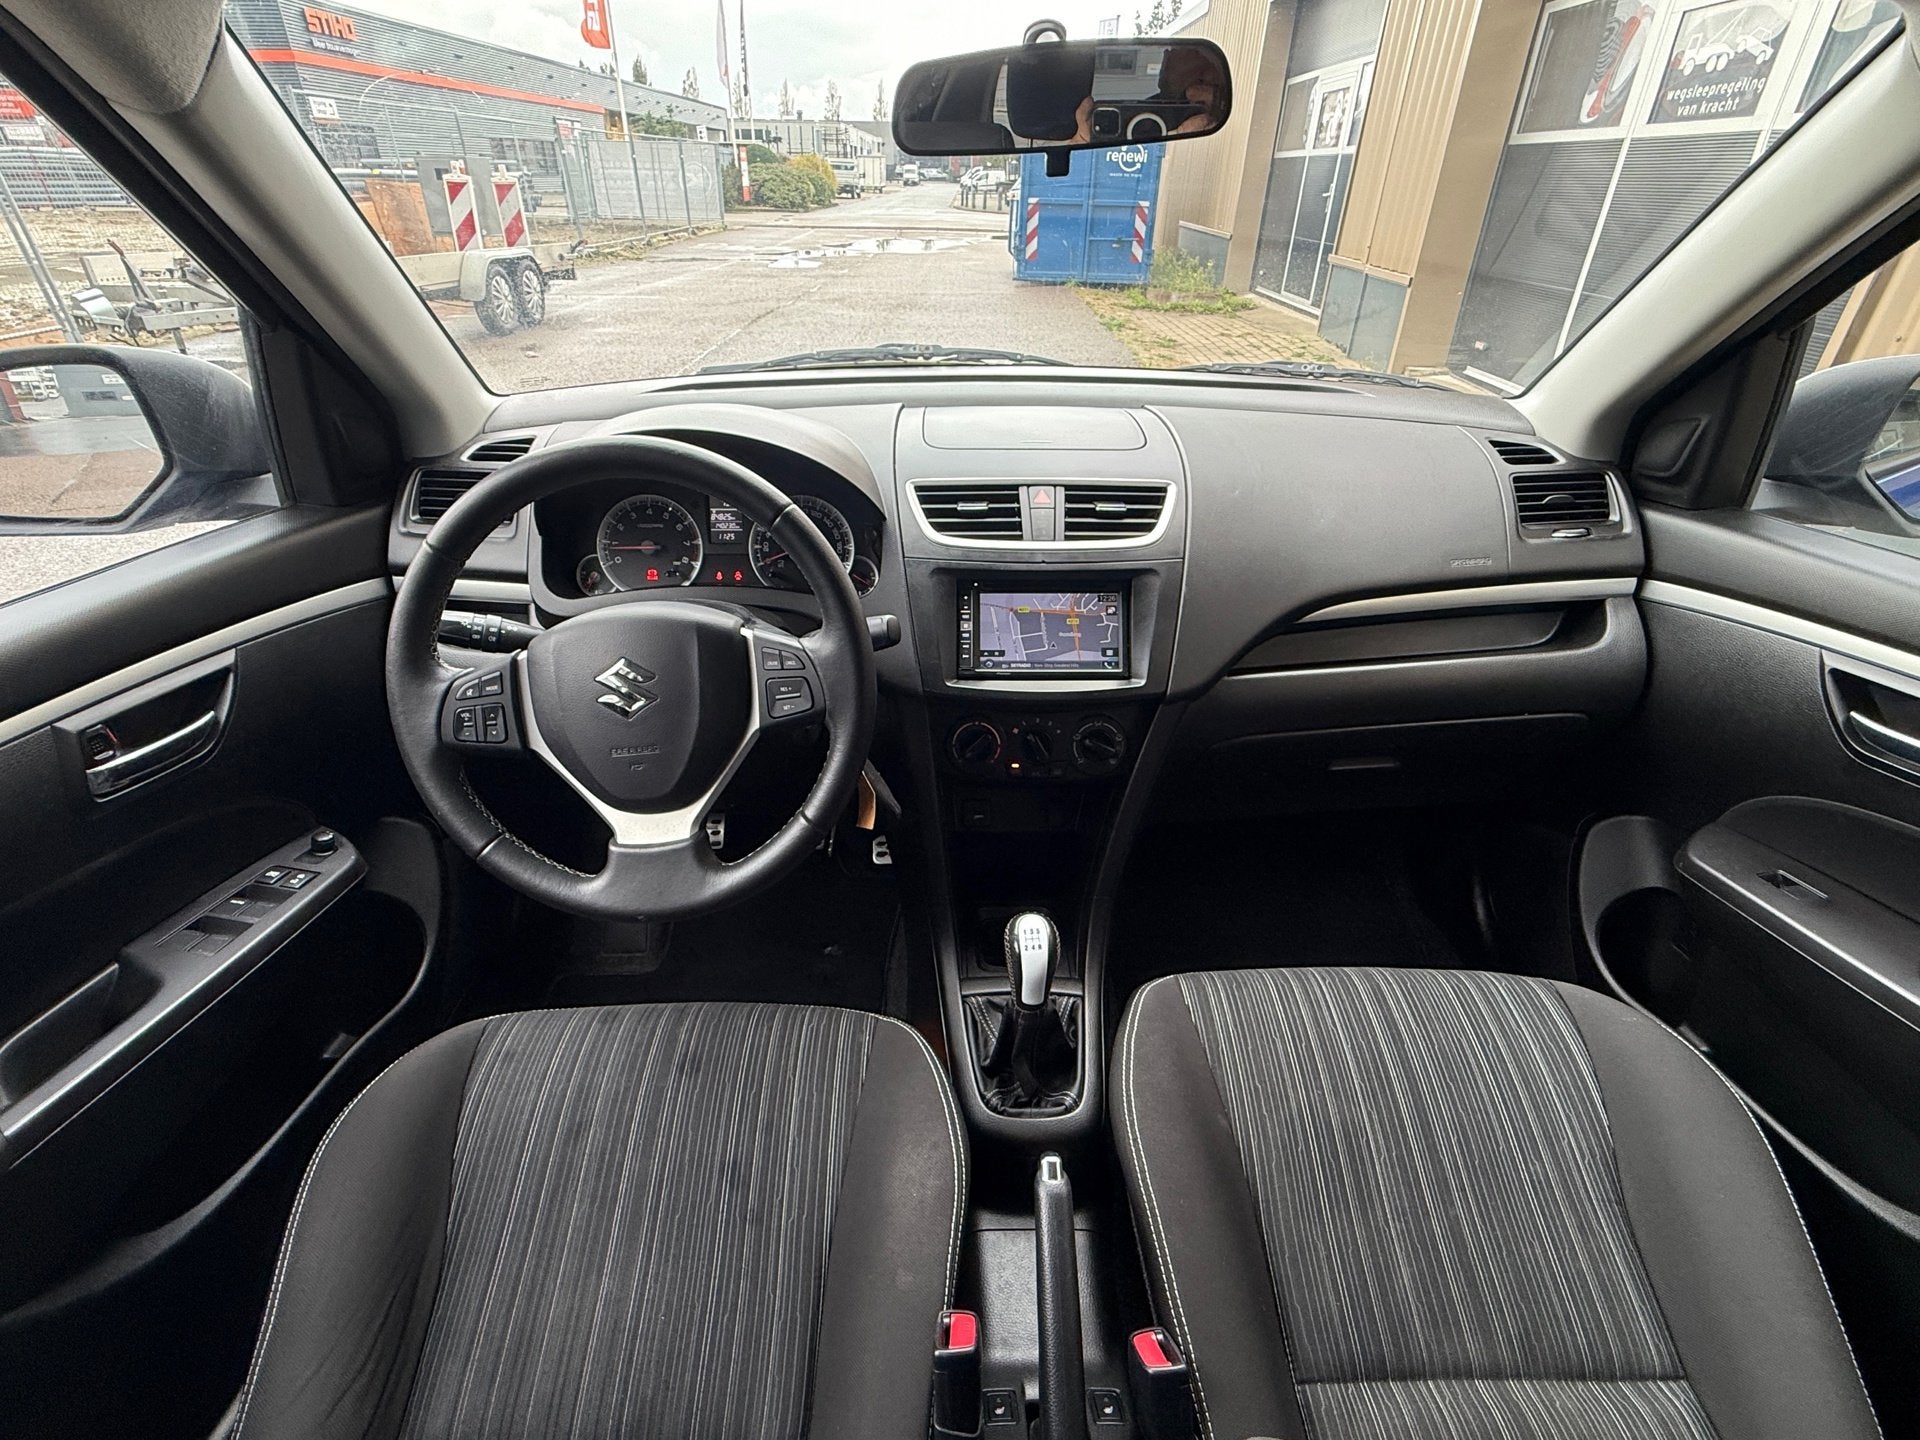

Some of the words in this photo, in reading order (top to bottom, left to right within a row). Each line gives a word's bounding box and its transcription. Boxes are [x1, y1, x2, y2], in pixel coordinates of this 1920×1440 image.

[1666, 77, 1766, 102] wegsleepregeling
[1677, 104, 1697, 117] van
[1699, 97, 1740, 115] kracht
[1106, 149, 1148, 163] renewi
